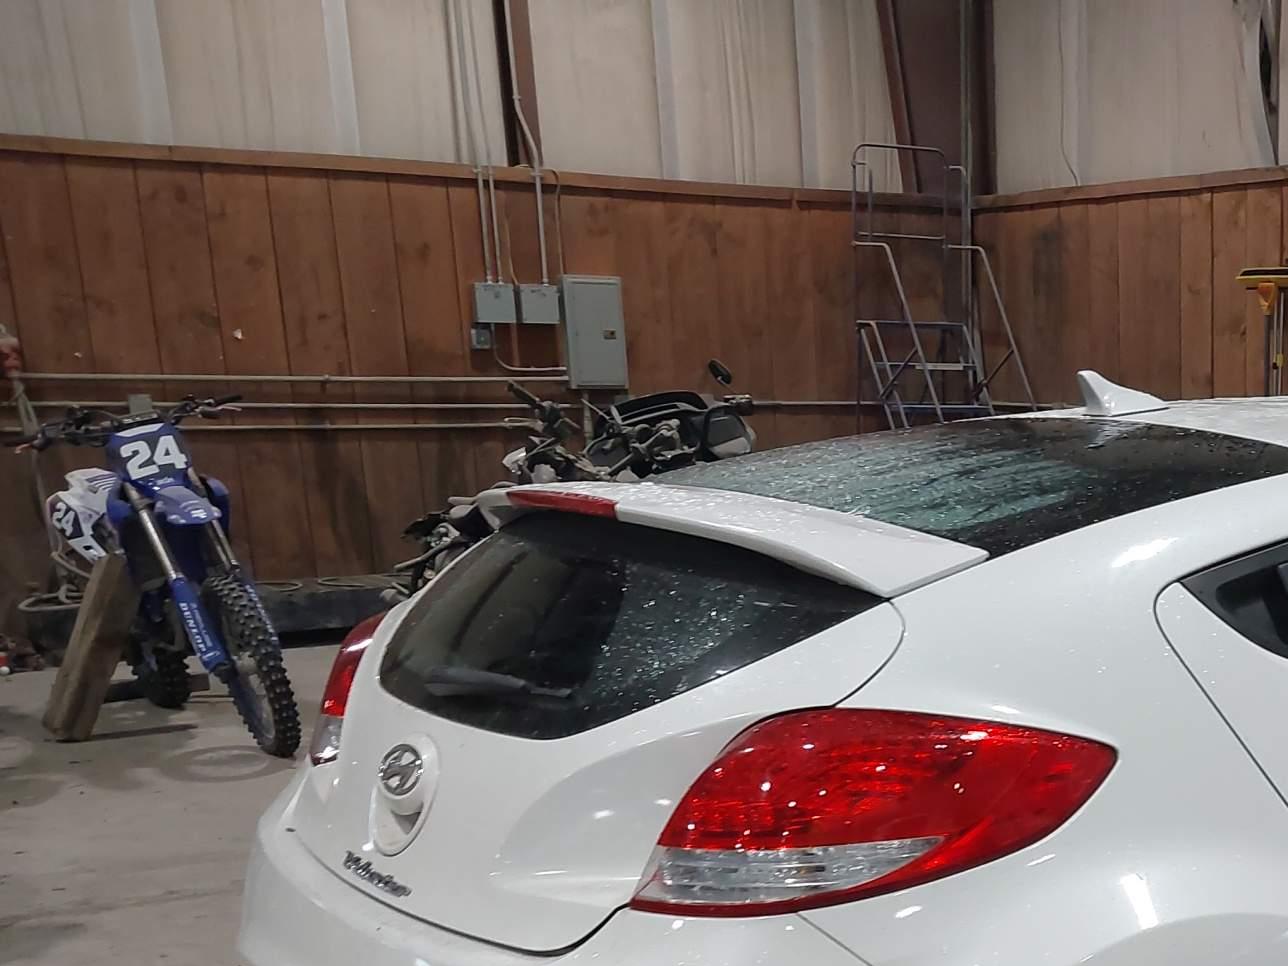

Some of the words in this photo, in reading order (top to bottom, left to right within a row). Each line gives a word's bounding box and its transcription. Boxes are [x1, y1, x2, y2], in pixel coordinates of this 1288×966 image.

[120, 435, 188, 481] 24
[52, 502, 76, 537] 24
[178, 602, 208, 658] DUNLOP
